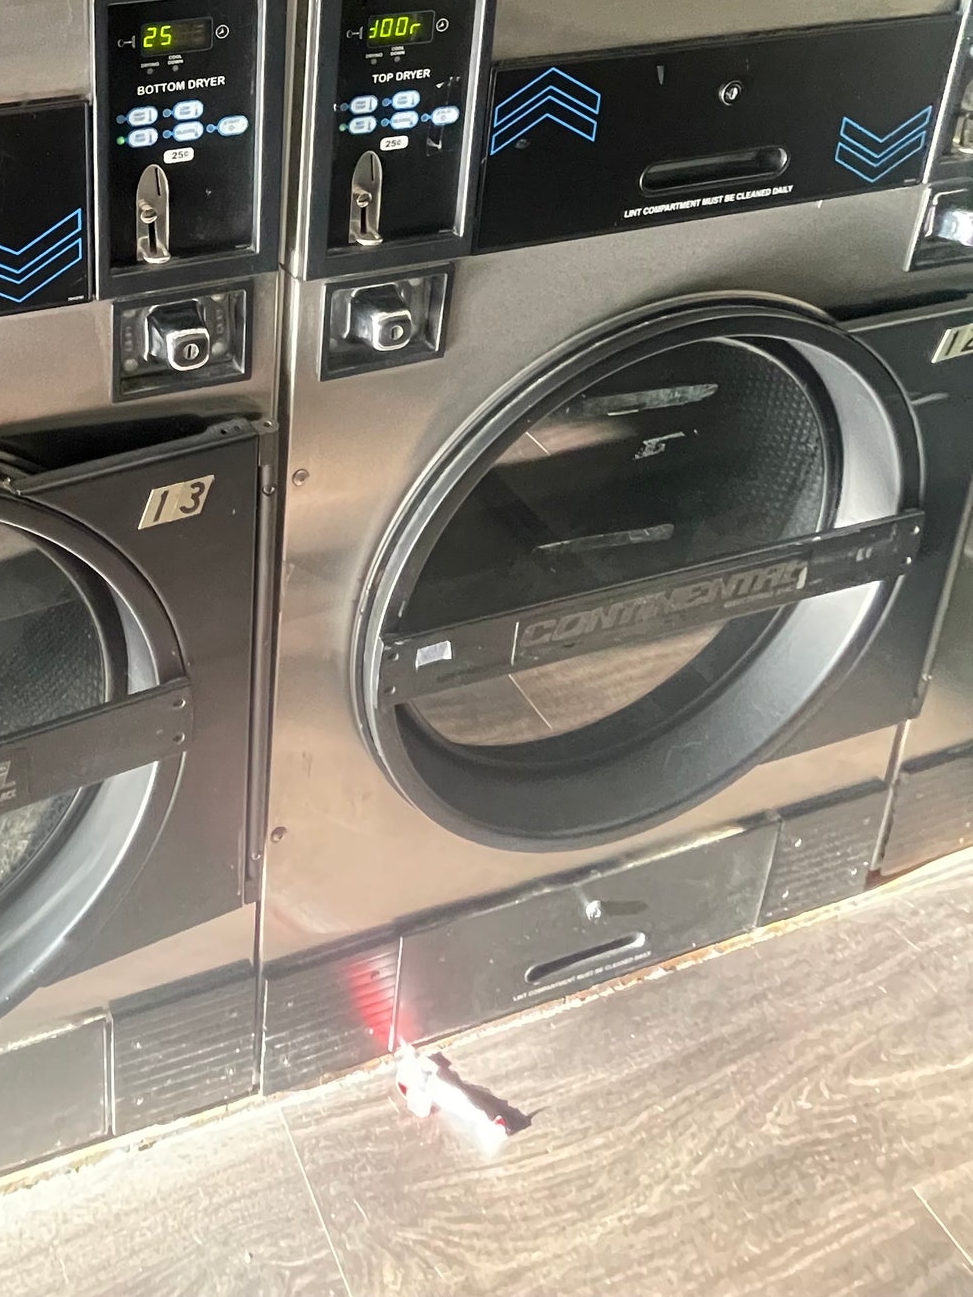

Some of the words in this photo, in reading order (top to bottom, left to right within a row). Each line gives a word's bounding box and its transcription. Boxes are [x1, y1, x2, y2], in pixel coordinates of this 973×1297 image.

[143, 25, 172, 48] 25
[137, 80, 185, 96] BOTTOM
[188, 75, 226, 89] DRYER
[372, 73, 394, 83] TOP
[395, 68, 431, 81] DRYER
[624, 208, 643, 218] LINT
[643, 199, 702, 216] COMPARTMENT
[702, 196, 723, 206] MUST
[724, 194, 735, 202] BE
[736, 188, 772, 201] CLEANED
[772, 185, 794, 195] DAILY
